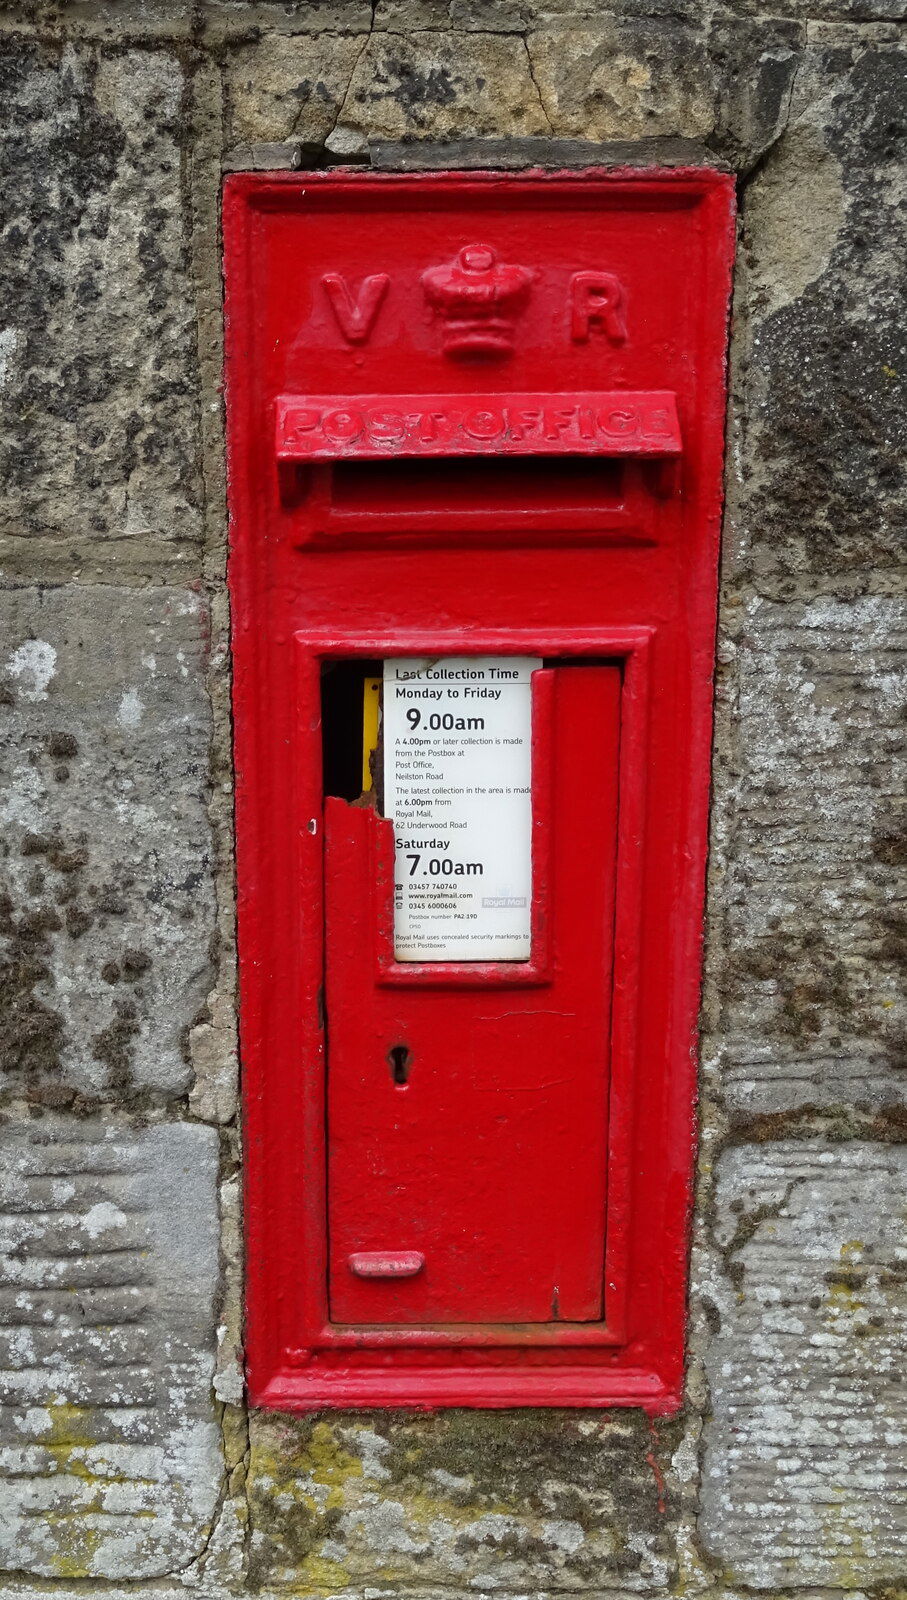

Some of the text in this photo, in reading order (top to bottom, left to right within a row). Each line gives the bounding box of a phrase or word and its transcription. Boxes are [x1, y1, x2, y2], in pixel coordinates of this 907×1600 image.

[320, 271, 628, 345] V R
[282, 403, 673, 446] POST OFFICE
[395, 668, 519, 680] Last Collection Time
[395, 688, 502, 700] Monday to Friday
[406, 708, 485, 731] 9.00am
[402, 738, 430, 747] 4.00pm
[412, 761, 434, 769] Office,
[404, 799, 432, 808] 6.00pm
[396, 810, 432, 819] Royal Mail,
[396, 838, 450, 850] Saturday
[406, 854, 483, 876] 7.00am
[484, 898, 506, 906] Royal
